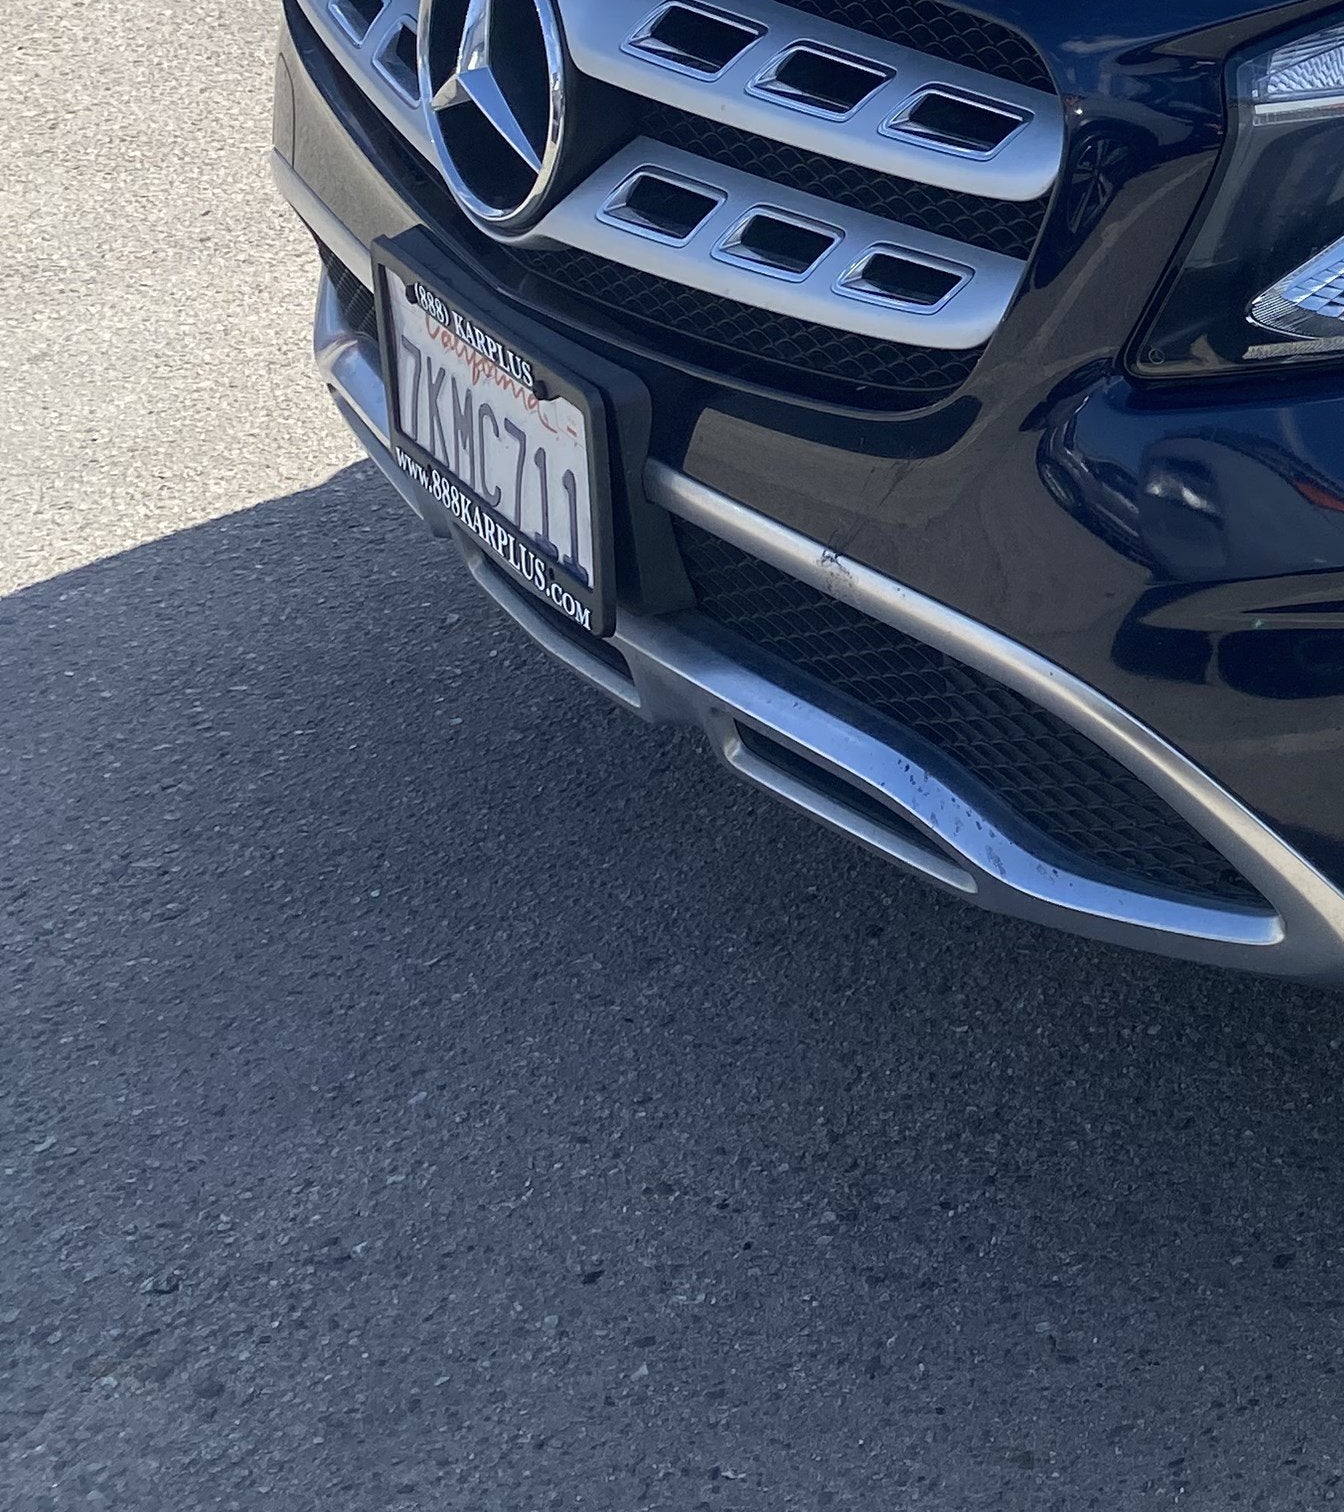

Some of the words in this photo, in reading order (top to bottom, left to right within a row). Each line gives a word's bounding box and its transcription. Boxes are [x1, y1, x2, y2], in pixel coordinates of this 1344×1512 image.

[415, 283, 450, 327] (888)
[452, 311, 534, 387] KARPLUS
[400, 334, 590, 587] 7KMC711
